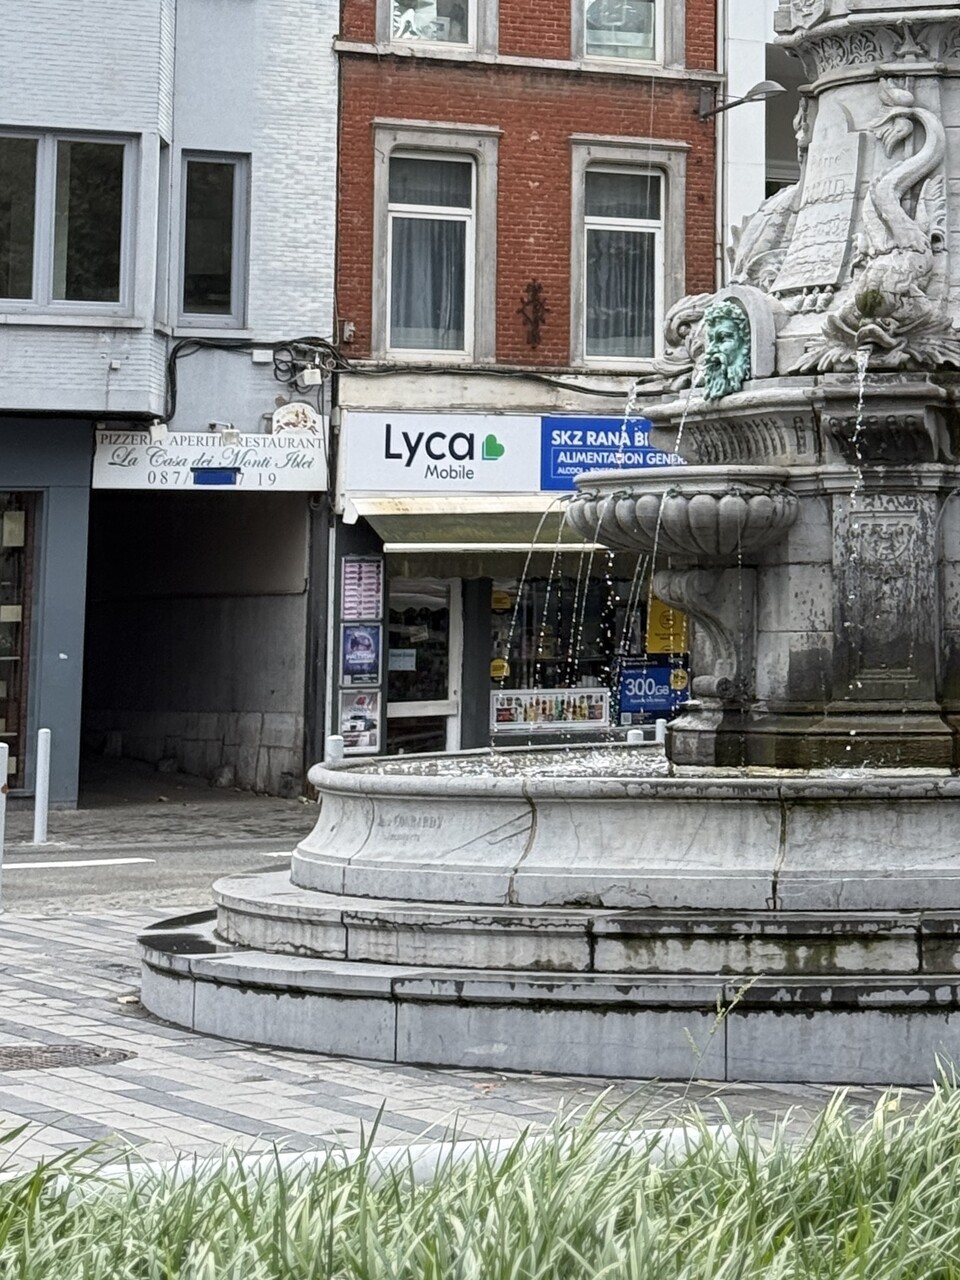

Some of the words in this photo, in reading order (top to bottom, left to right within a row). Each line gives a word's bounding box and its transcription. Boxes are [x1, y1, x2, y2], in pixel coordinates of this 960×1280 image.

[170, 435, 225, 447] APERITI
[236, 437, 323, 450] RESTAURANT
[385, 423, 475, 467] Lyca
[551, 429, 583, 446] SKZ
[587, 430, 631, 447] RANA
[634, 431, 649, 447] B
[108, 446, 138, 468] La
[146, 446, 188, 467] Casa
[191, 453, 215, 467] dei
[218, 448, 272, 468] Monti
[646, 453, 688, 465] GENER
[258, 471, 277, 486] 19
[424, 464, 475, 480] Mobile
